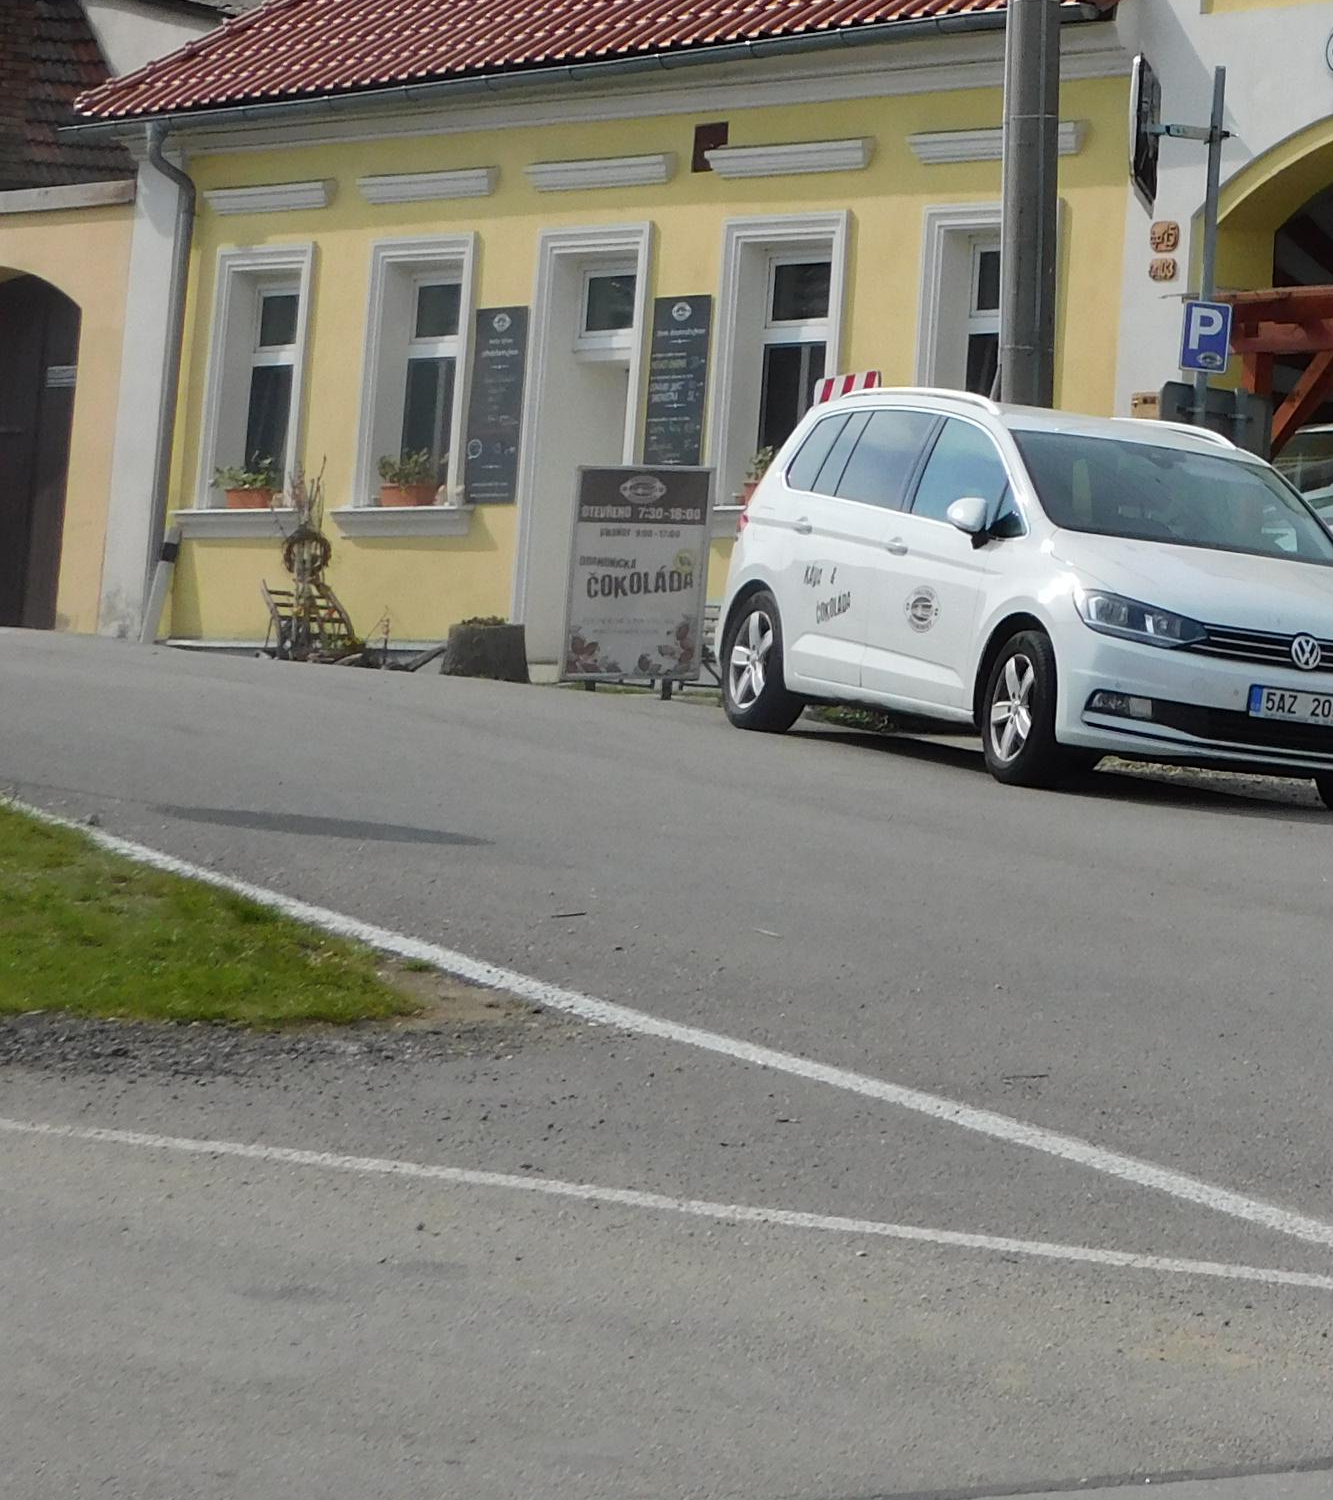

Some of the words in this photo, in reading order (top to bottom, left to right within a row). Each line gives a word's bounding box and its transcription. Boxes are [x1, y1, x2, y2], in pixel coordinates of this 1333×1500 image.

[1188, 306, 1223, 350] P
[587, 565, 694, 599] ČOKOLÁDA
[1265, 691, 1298, 714] 5AZ
